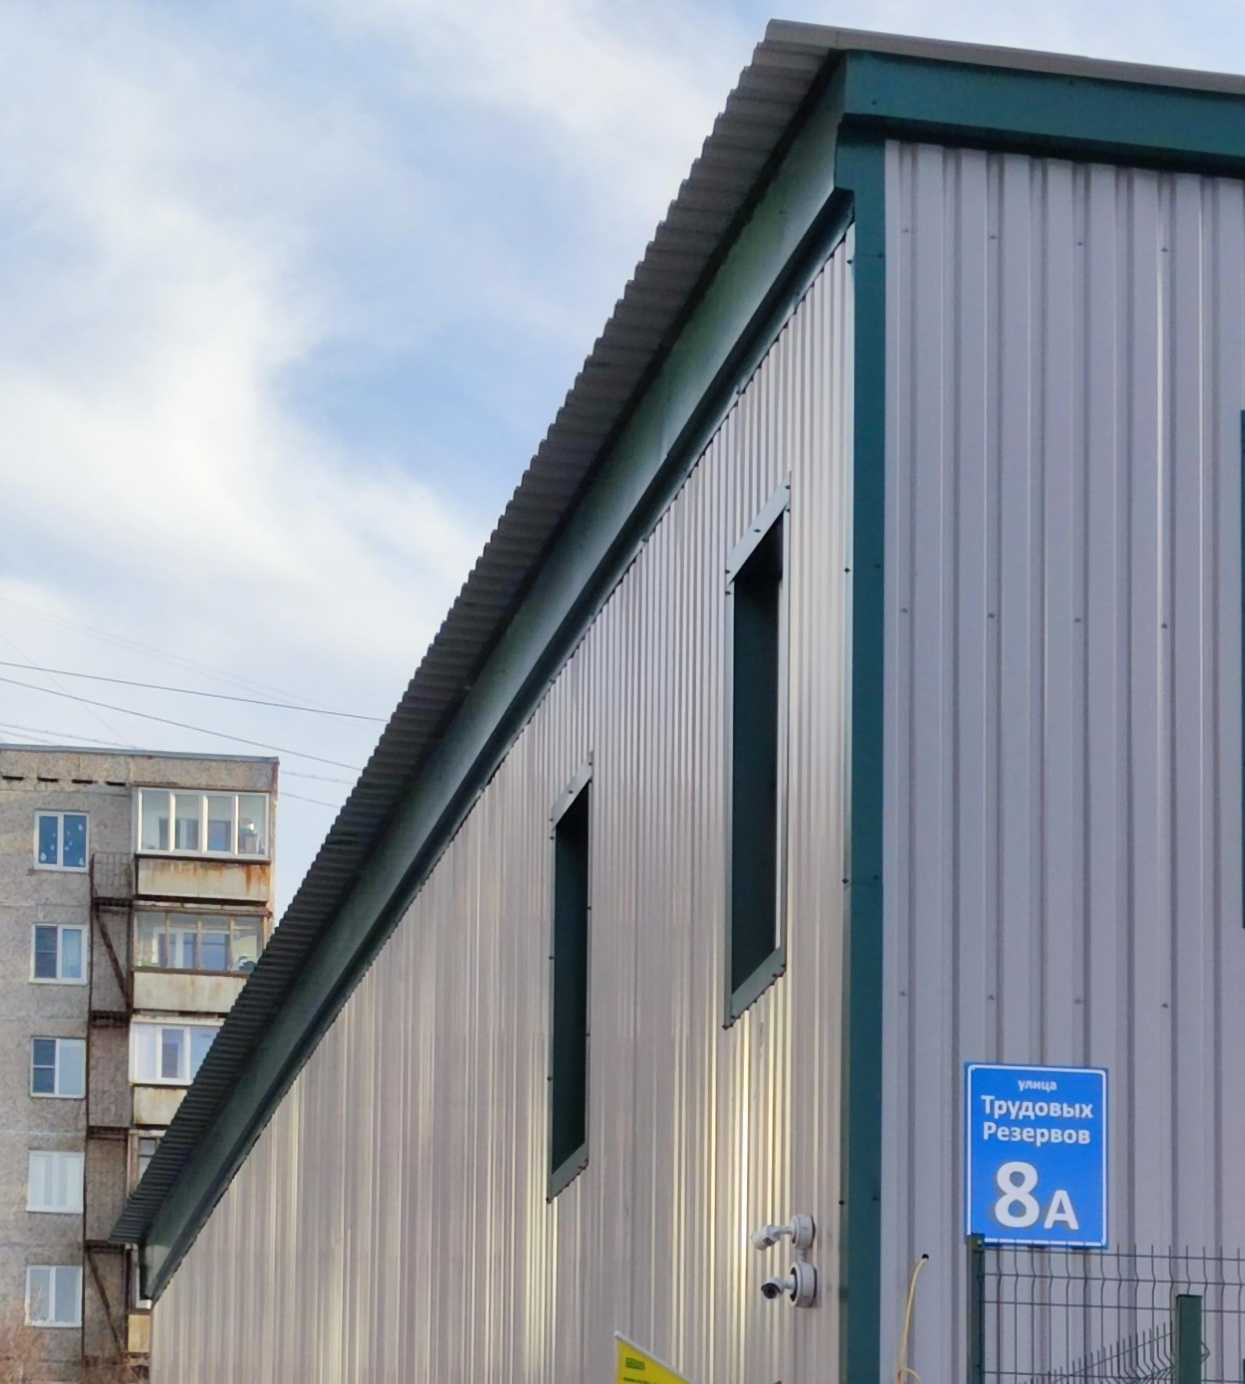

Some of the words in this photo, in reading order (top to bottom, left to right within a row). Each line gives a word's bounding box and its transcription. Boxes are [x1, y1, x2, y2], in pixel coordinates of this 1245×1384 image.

[1018, 1079, 1057, 1091] улица
[981, 1095, 1093, 1120] Трудовых
[983, 1121, 1091, 1147] Резервов
